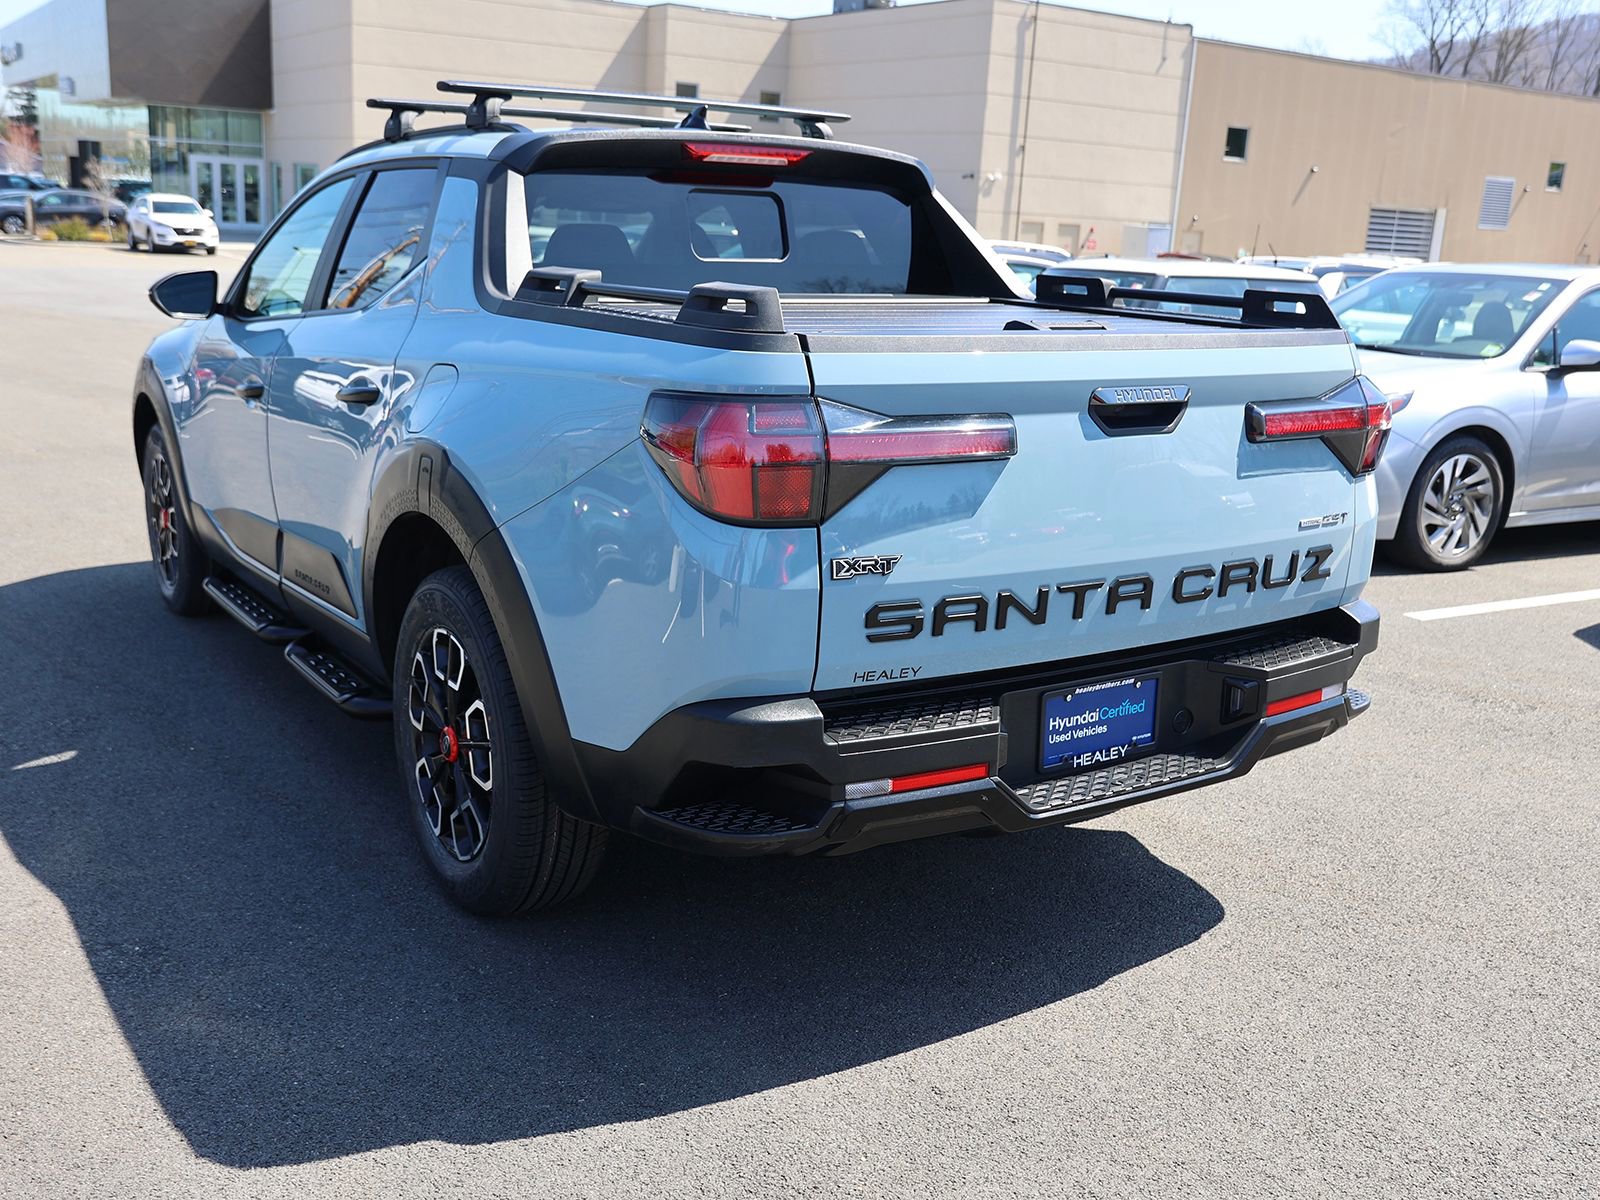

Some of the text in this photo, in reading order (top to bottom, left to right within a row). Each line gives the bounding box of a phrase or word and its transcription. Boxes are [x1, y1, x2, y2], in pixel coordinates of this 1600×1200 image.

[1114, 387, 1178, 403] HYUNDAI
[830, 555, 903, 580] XRT
[864, 543, 1334, 643] SANTA CRUZ
[853, 665, 922, 683] HEALEY
[1074, 678, 1135, 695] healeybrothers.com
[1049, 699, 1146, 732] Hyundai Certified
[1048, 724, 1108, 744] Used Vehicles
[1073, 744, 1129, 768] HEALEY
